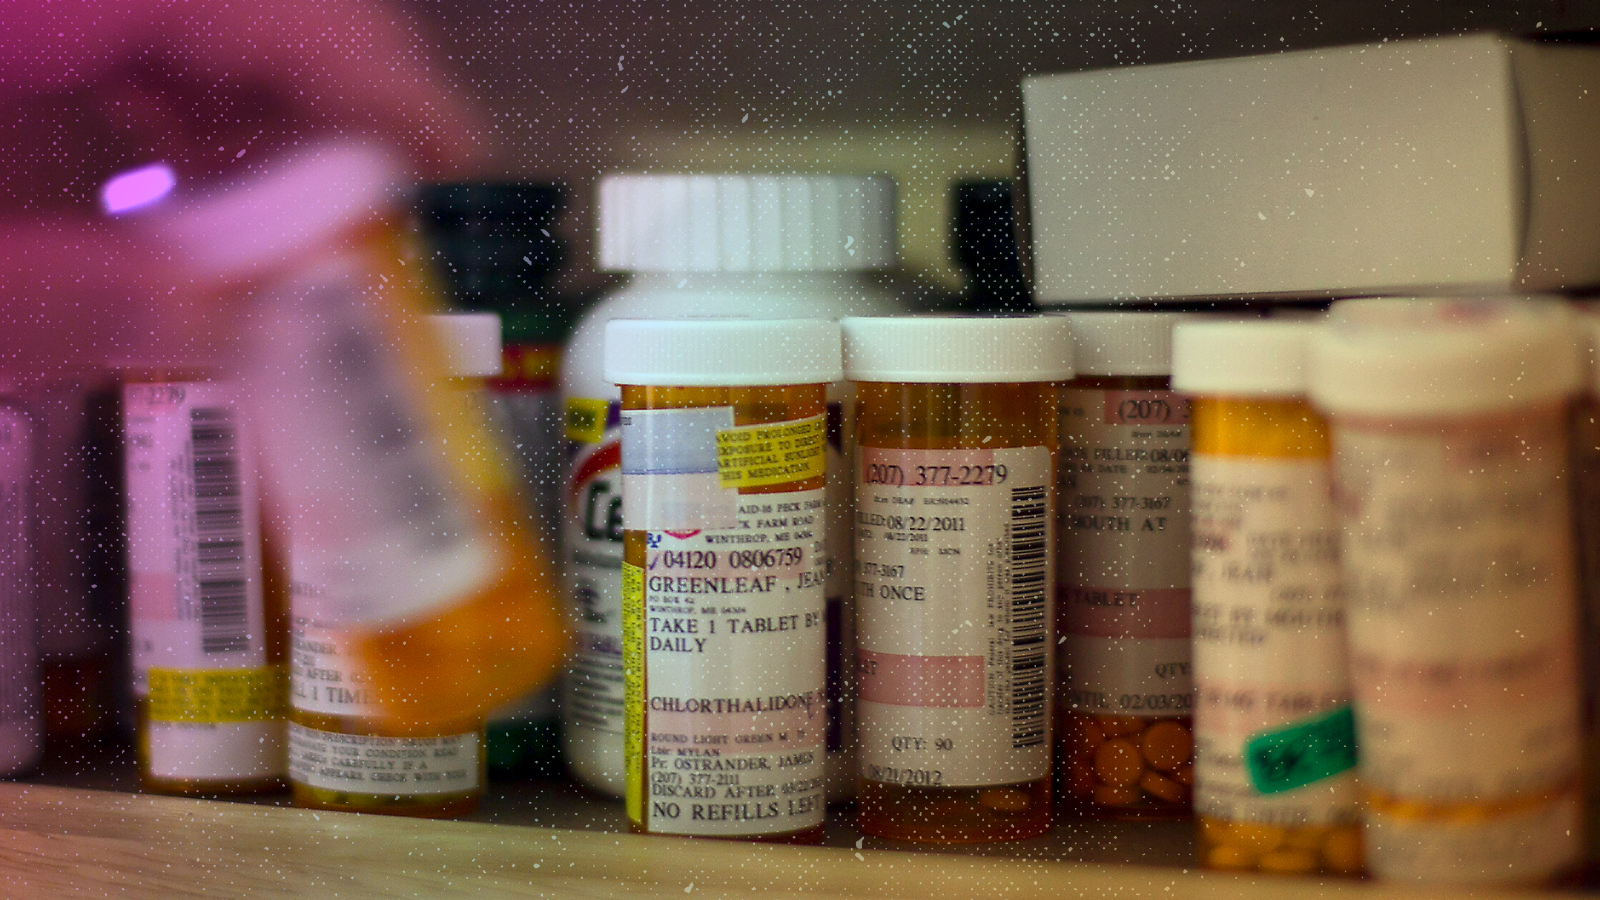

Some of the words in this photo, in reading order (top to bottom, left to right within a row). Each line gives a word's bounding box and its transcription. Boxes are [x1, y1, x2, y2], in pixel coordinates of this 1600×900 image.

[1119, 399, 1170, 423] (207)
[867, 463, 905, 488] (207)
[915, 464, 1008, 486] 377-2279
[757, 518, 788, 529] FARM
[886, 515, 965, 532] 08/22/2011
[1141, 517, 1168, 532] AT
[664, 550, 717, 569] 04120
[729, 547, 803, 569] 0806759
[649, 575, 777, 594] GREENLEAF
[880, 584, 926, 602] ONCE
[1073, 590, 1138, 608] TABLET
[650, 617, 698, 635] TAKE
[709, 619, 716, 635] 1
[727, 614, 800, 635] TABLET
[650, 636, 707, 653] DAILY
[650, 693, 814, 714] CHLORTHALIDONE
[734, 732, 773, 744] GREEN
[891, 736, 927, 752] QTY:
[934, 737, 953, 751] 90
[778, 751, 814, 768] JAMES
[651, 771, 682, 785] (207)
[690, 772, 740, 786] 377-2111
[652, 783, 716, 800] DISCARD
[724, 784, 775, 799] AFTER
[652, 801, 681, 819] NO
[692, 802, 779, 821] REFILLS
[788, 793, 822, 816] LEFT
